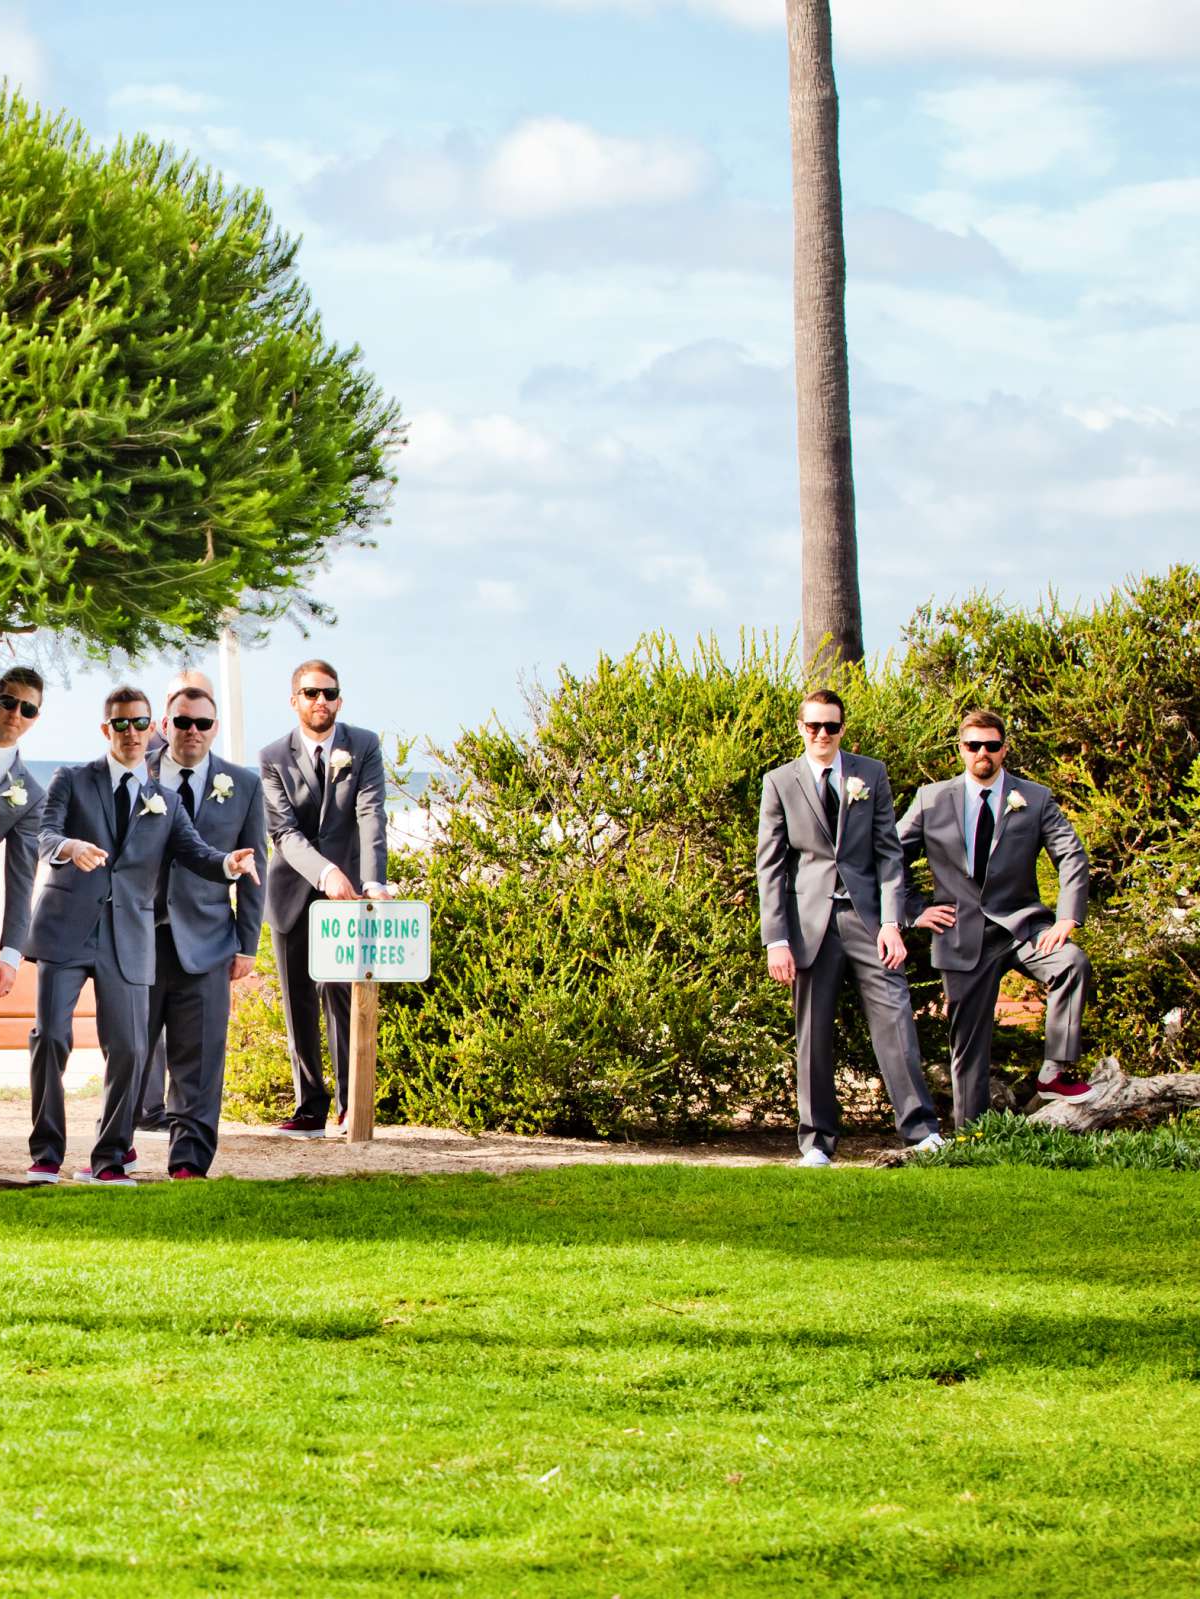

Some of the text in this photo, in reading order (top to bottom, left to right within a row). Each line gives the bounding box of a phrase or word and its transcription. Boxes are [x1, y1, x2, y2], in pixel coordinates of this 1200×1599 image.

[321, 918, 420, 938] NO CLIMBING
[335, 945, 405, 964] ON TREES
